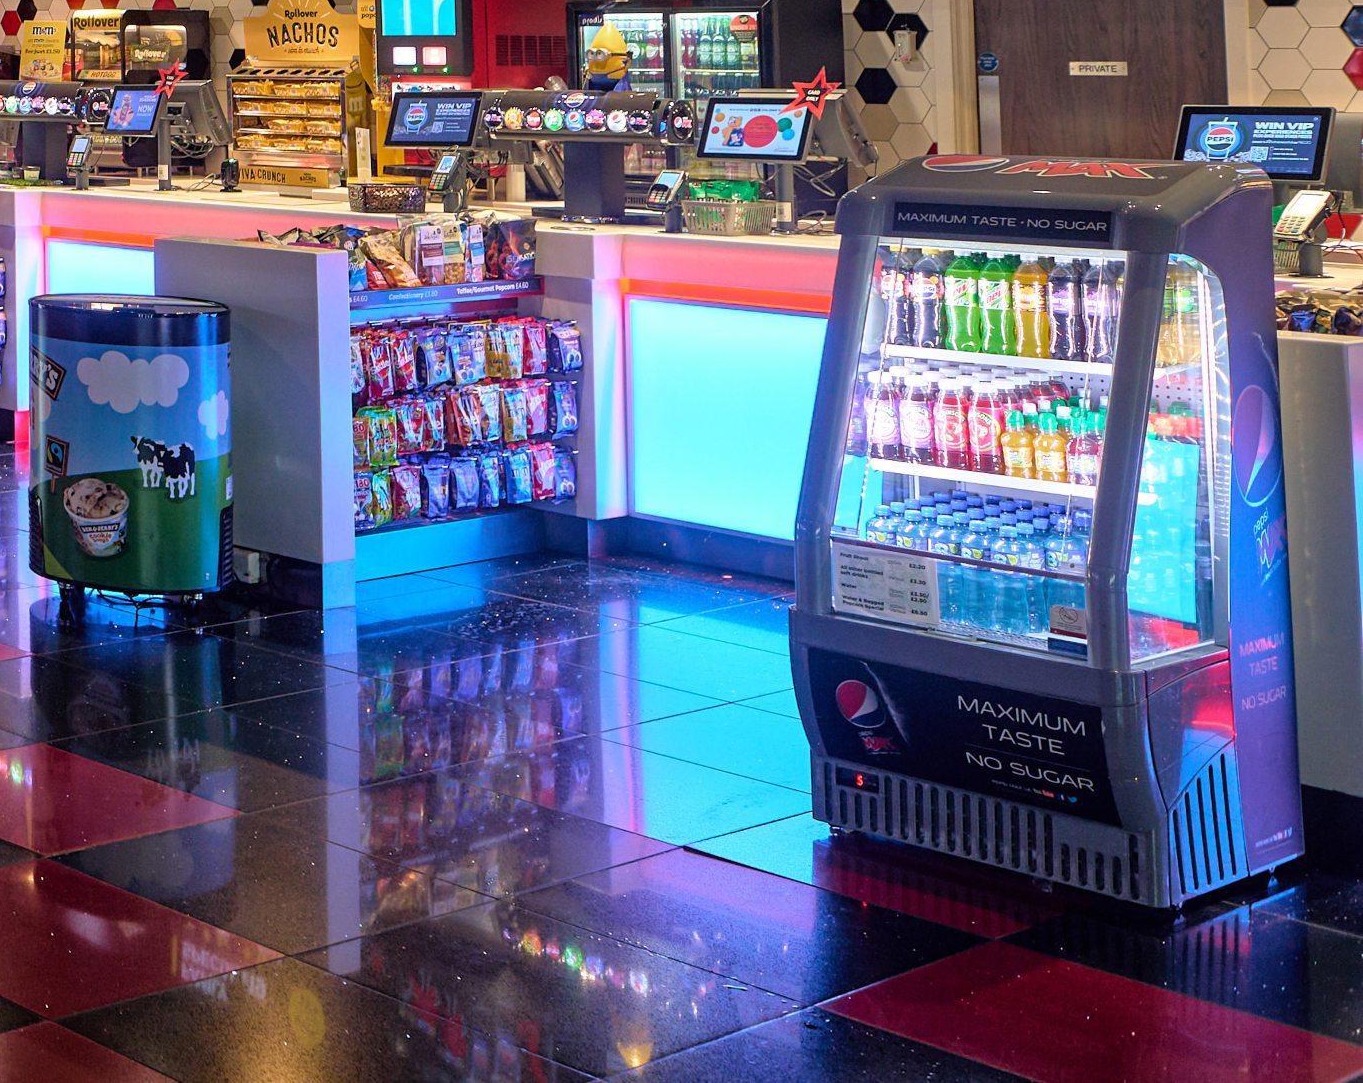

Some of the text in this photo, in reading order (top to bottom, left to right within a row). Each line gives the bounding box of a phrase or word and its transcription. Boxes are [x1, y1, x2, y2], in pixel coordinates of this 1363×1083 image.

[74, 17, 120, 29] Rollover
[284, 9, 318, 19] Rollover
[267, 22, 339, 48] NACHOS
[134, 48, 166, 61] Rollover
[1078, 64, 1118, 73] PRIVATE
[1255, 122, 1315, 130] WIN VIP
[256, 169, 286, 184] CRUNCH
[994, 160, 1180, 179] MAX
[897, 212, 1107, 231] MAXIMUM TASTE NO SUGAR
[388, 292, 424, 300] Confectionery
[457, 285, 494, 295] Toffee/Gourmet
[495, 284, 515, 292] Popcorn
[1238, 633, 1285, 656] MAXIMUM
[1249, 657, 1278, 677] TASTE
[1241, 686, 1287, 710] NO SUGAR
[957, 694, 1086, 737] MAXIMUM
[982, 724, 1066, 756] TASTE
[965, 751, 1095, 792] NO SUGAR
